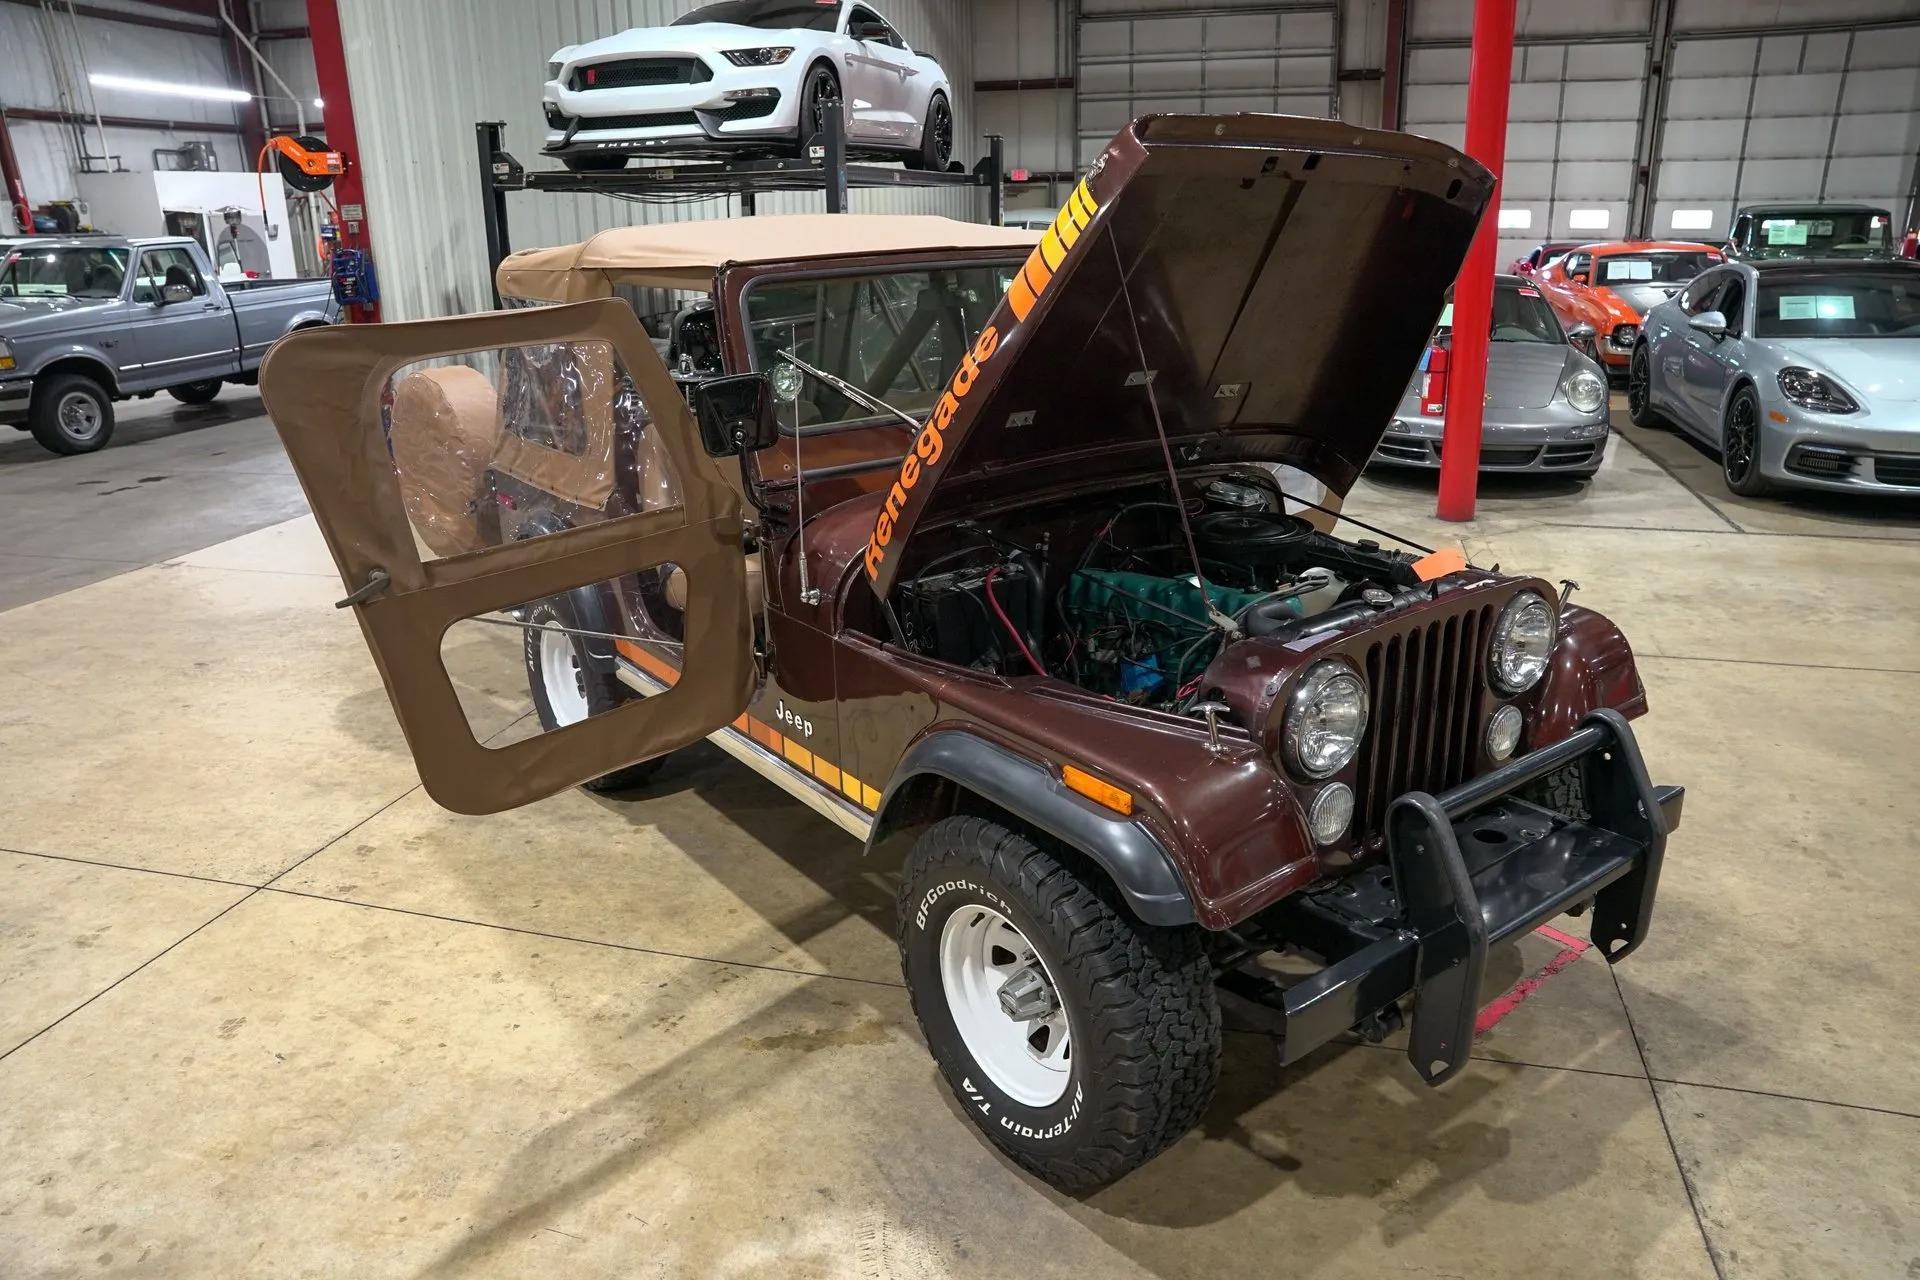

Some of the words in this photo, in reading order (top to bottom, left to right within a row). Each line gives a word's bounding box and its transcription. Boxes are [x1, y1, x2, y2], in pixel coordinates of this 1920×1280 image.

[864, 325, 999, 582] Renegade
[775, 700, 813, 738] Jeep
[916, 880, 1012, 931] BFGoodrich
[962, 1077, 991, 1116] T/A
[1000, 1081, 1083, 1139] All-Terrain
